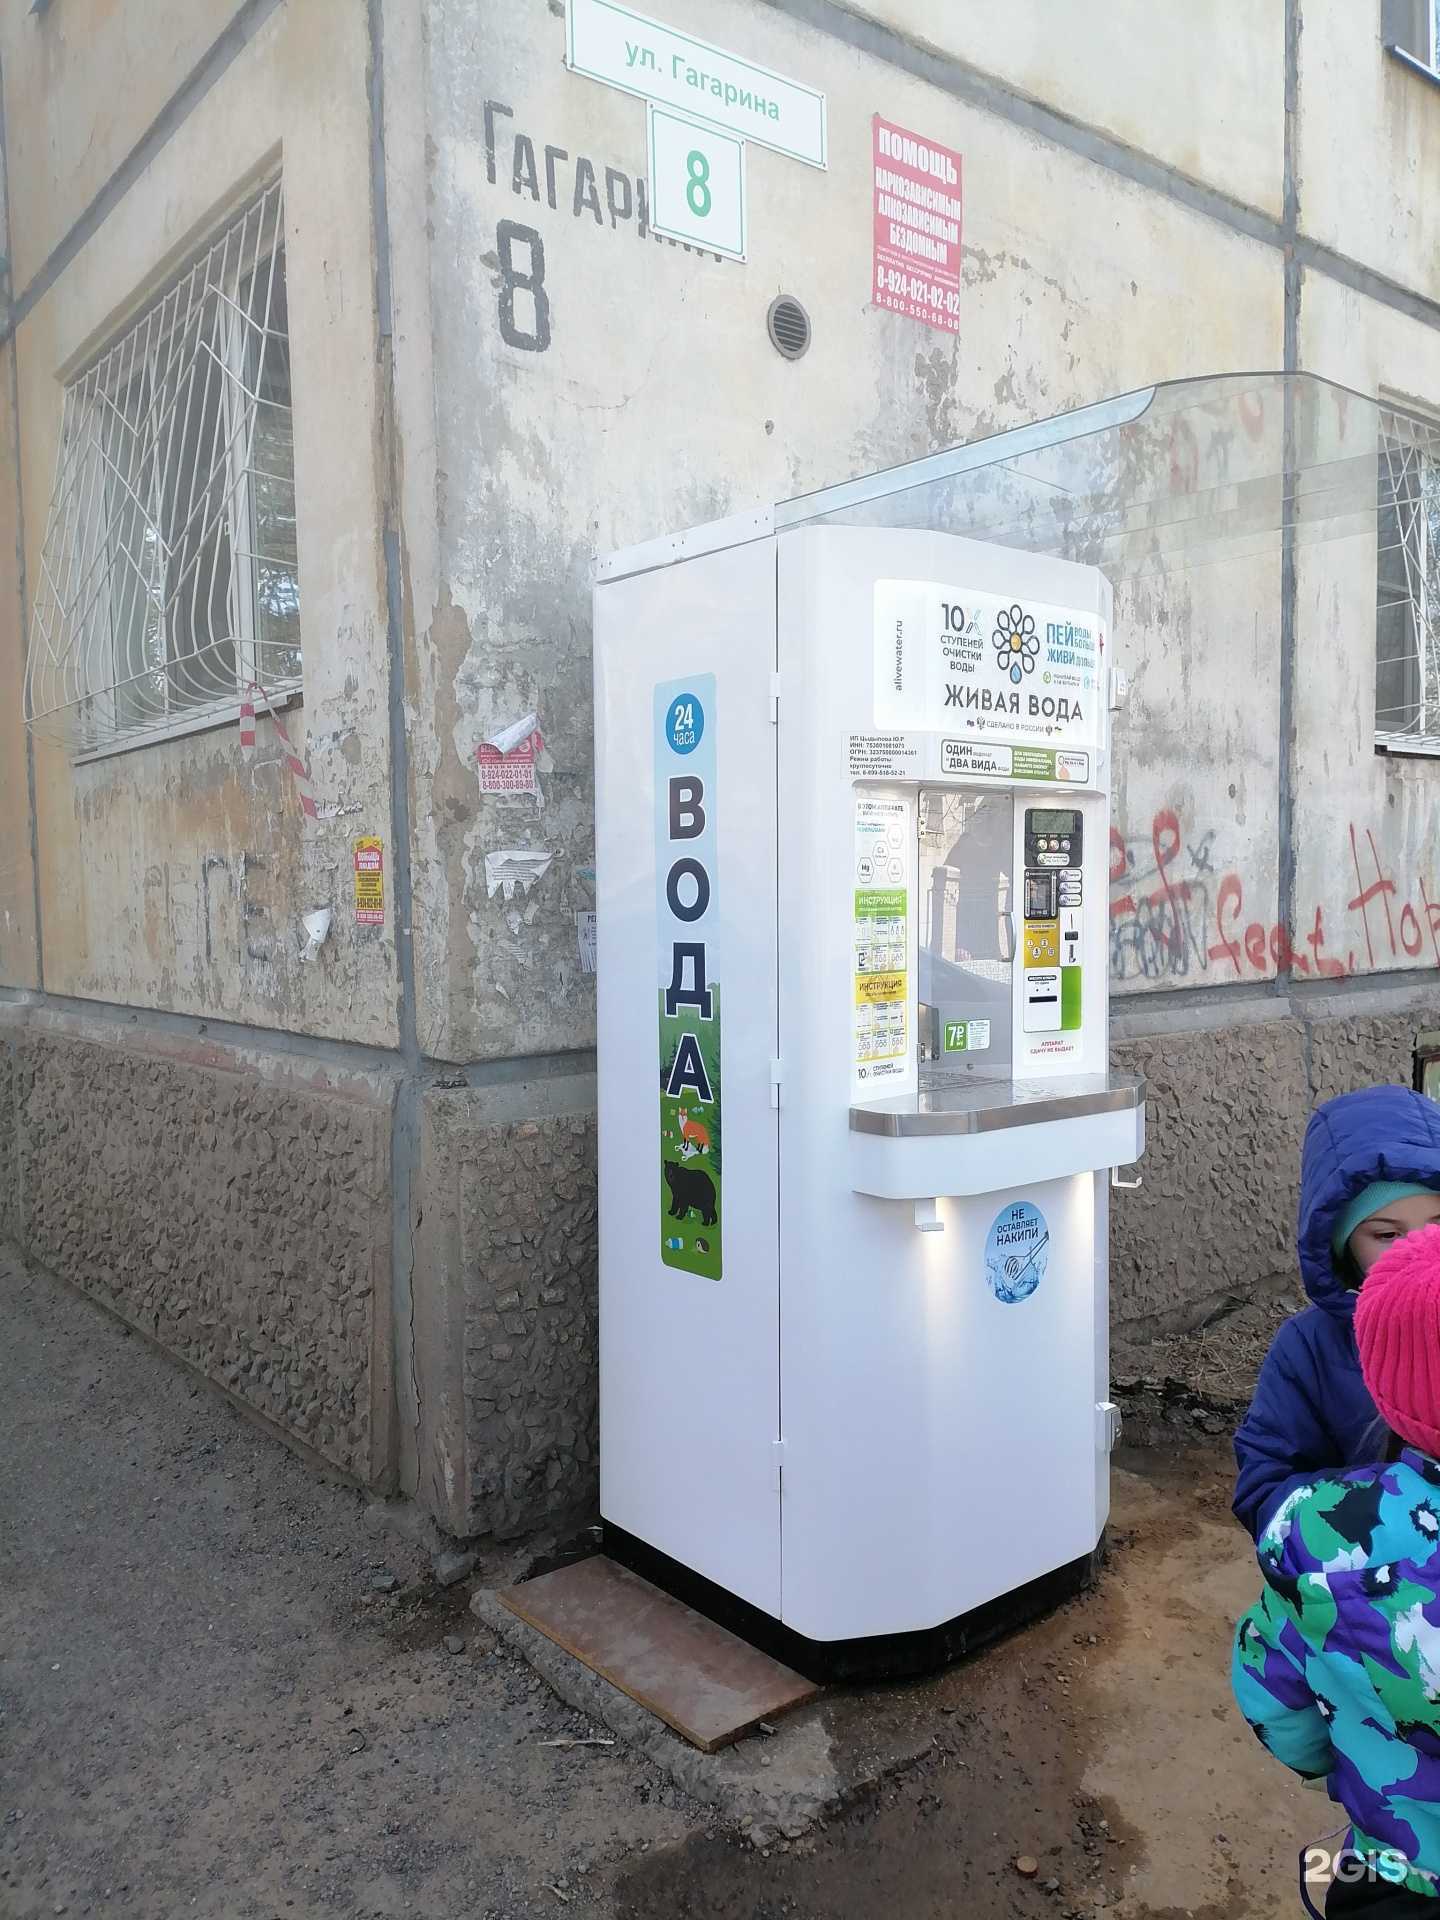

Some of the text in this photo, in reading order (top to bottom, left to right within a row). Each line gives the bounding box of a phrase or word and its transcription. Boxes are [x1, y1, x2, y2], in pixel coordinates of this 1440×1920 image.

[625, 41, 780, 121] ул. Гагарина
[879, 127, 957, 185] ПОМОЩЬ
[686, 150, 712, 218] 8
[875, 166, 961, 221] НАРКОЗАВИСИМЫМ
[878, 192, 959, 245] АЛКОЗАВИСИМЫМ
[889, 222, 948, 265] БЕЗДОМНЫМ
[497, 219, 550, 352] 8
[877, 264, 960, 315] 8-924-021-02-02
[940, 635, 984, 649] СТУПЕНЕЙ
[1046, 621, 1074, 648] ПЕЙ
[894, 620, 903, 691] alivewater.ru
[942, 647, 982, 661] ОЧИСТКИ
[949, 661, 976, 673] ВОДЫ
[1047, 648, 1075, 665] ЖИВИ
[944, 683, 1083, 723] ЖИВАЯ ВОДА
[675, 704, 694, 731] 24
[673, 731, 696, 746] часа
[946, 744, 973, 756] ОДИН
[949, 758, 969, 769] ДВА
[971, 760, 997, 771] ВИДА
[664, 775, 713, 1102] ВОДА
[997, 1219, 1039, 1233] ОСТАВЛЯЕТ
[1012, 1209, 1025, 1220] НЕ
[997, 1227, 1038, 1246] НАКИПИ
